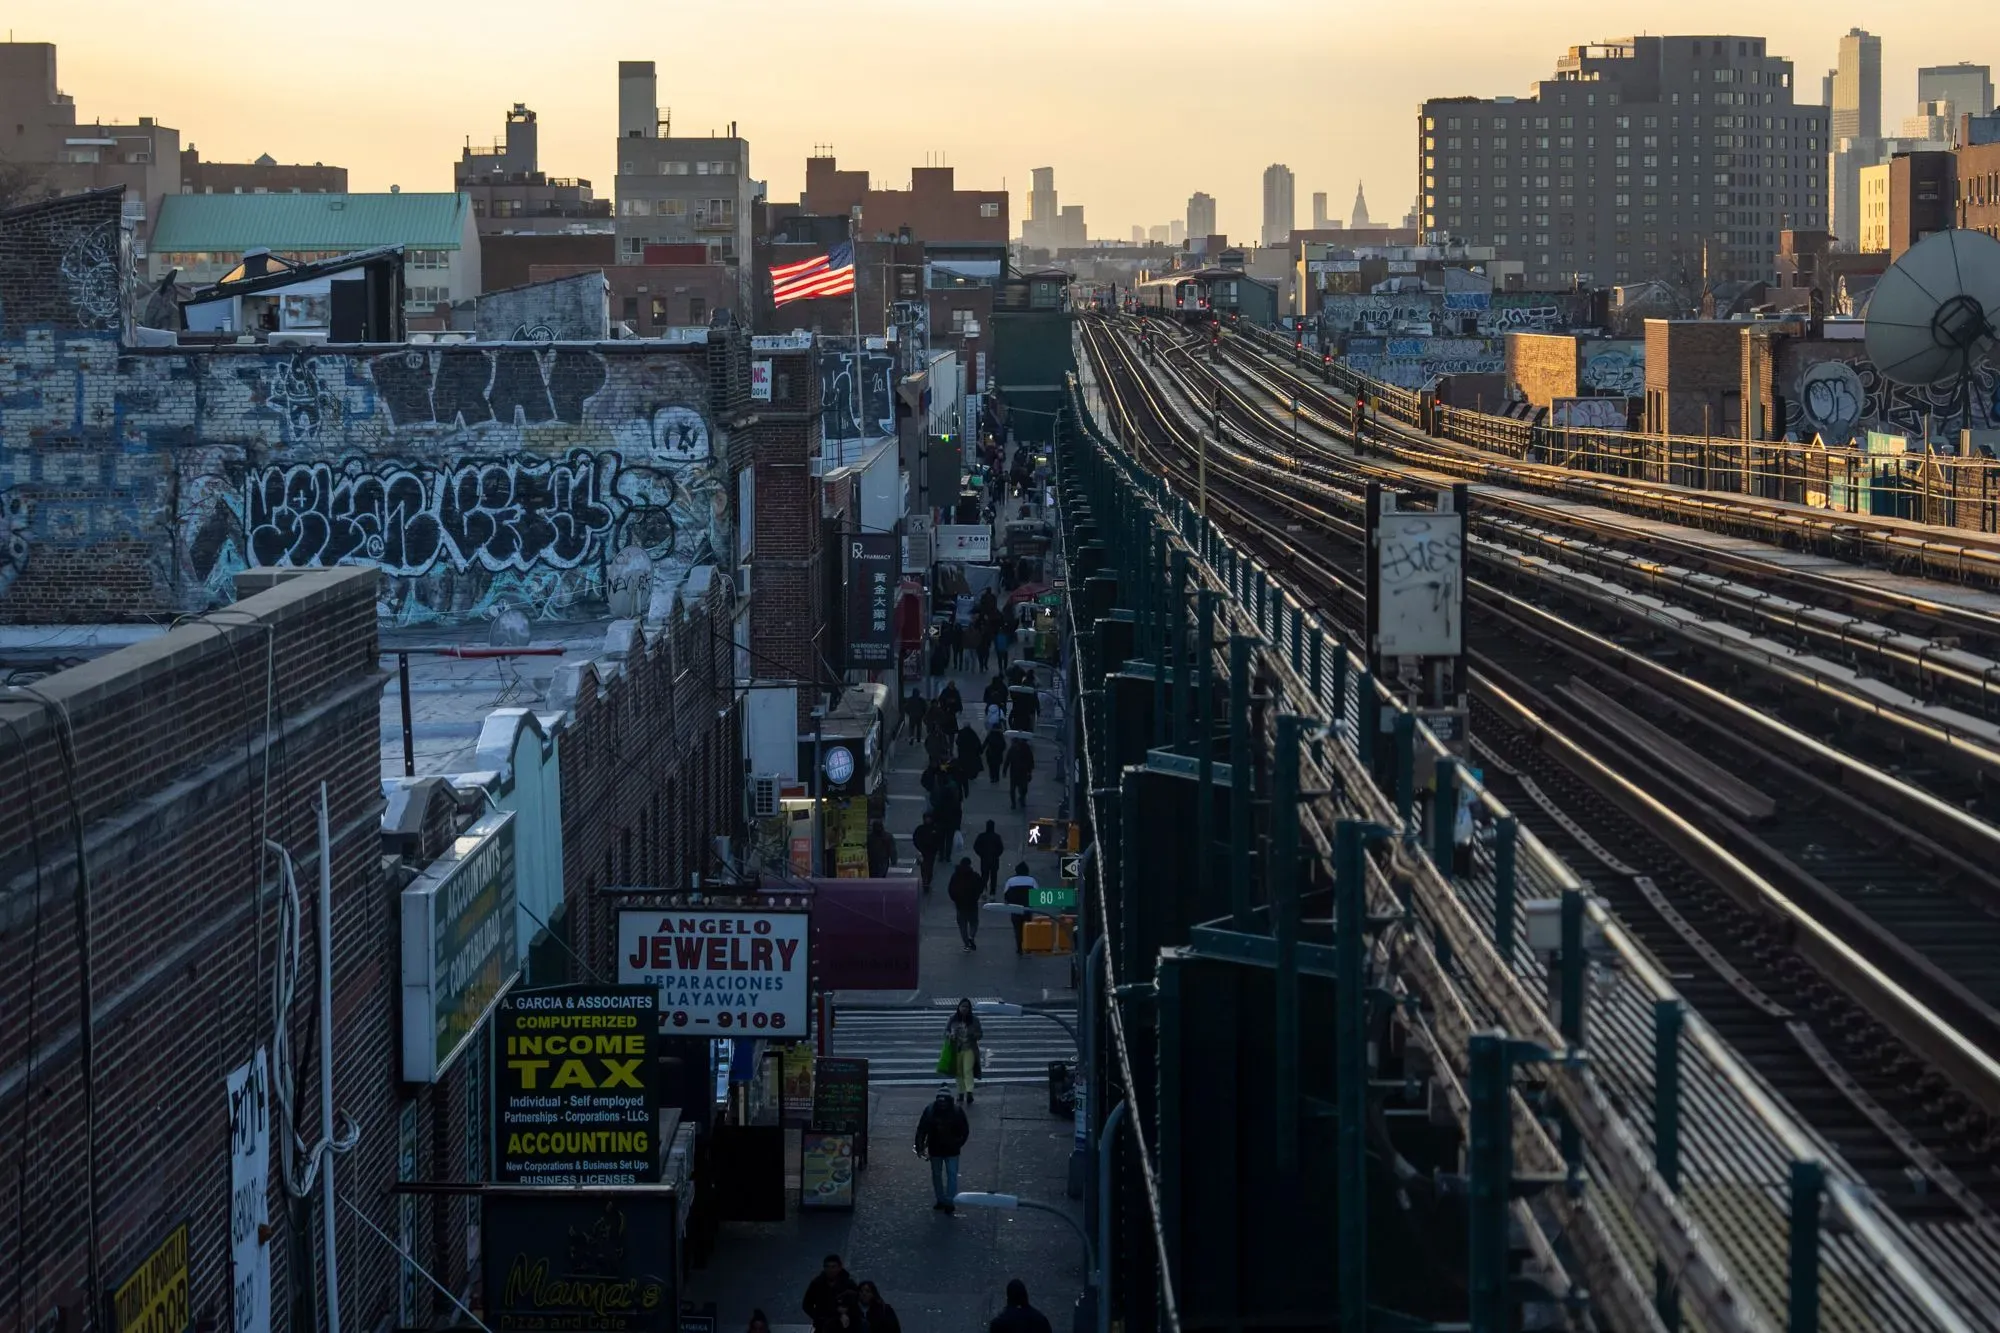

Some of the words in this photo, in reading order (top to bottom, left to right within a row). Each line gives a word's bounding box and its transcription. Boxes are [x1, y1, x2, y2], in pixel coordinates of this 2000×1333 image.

[447, 836, 501, 926] ACCOUNTANTS
[1040, 891, 1053, 904] 80
[657, 918, 771, 935] ANGELO
[450, 909, 500, 998] CONTABILIDAD
[630, 936, 799, 971] JEWELRY
[501, 997, 512, 1010] A.
[516, 996, 562, 1009] GARCIA
[566, 996, 574, 1009] &
[577, 996, 652, 1009] ASSOCIATES
[667, 993, 760, 1007] LAYAWAY
[516, 1015, 637, 1029] COMPUTERIZED
[507, 1035, 645, 1055] INCOME
[507, 1059, 645, 1089] TAX
[510, 1095, 560, 1107] Individual
[570, 1095, 590, 1107] Self
[593, 1095, 644, 1109] employed
[504, 1111, 558, 1125] Partnerships
[565, 1110, 620, 1124] Corporations
[627, 1111, 649, 1122] LLCs
[507, 1131, 649, 1154] ACCOUNTING
[506, 1161, 522, 1171] New
[524, 1161, 573, 1172] Corporations
[575, 1161, 581, 1170] &
[583, 1160, 617, 1170] Business
[619, 1160, 632, 1170] Set
[634, 1161, 649, 1171] Ups
[504, 1252, 662, 1316] Mama's
[501, 1314, 545, 1330] Pizza
[551, 1313, 582, 1330] and
